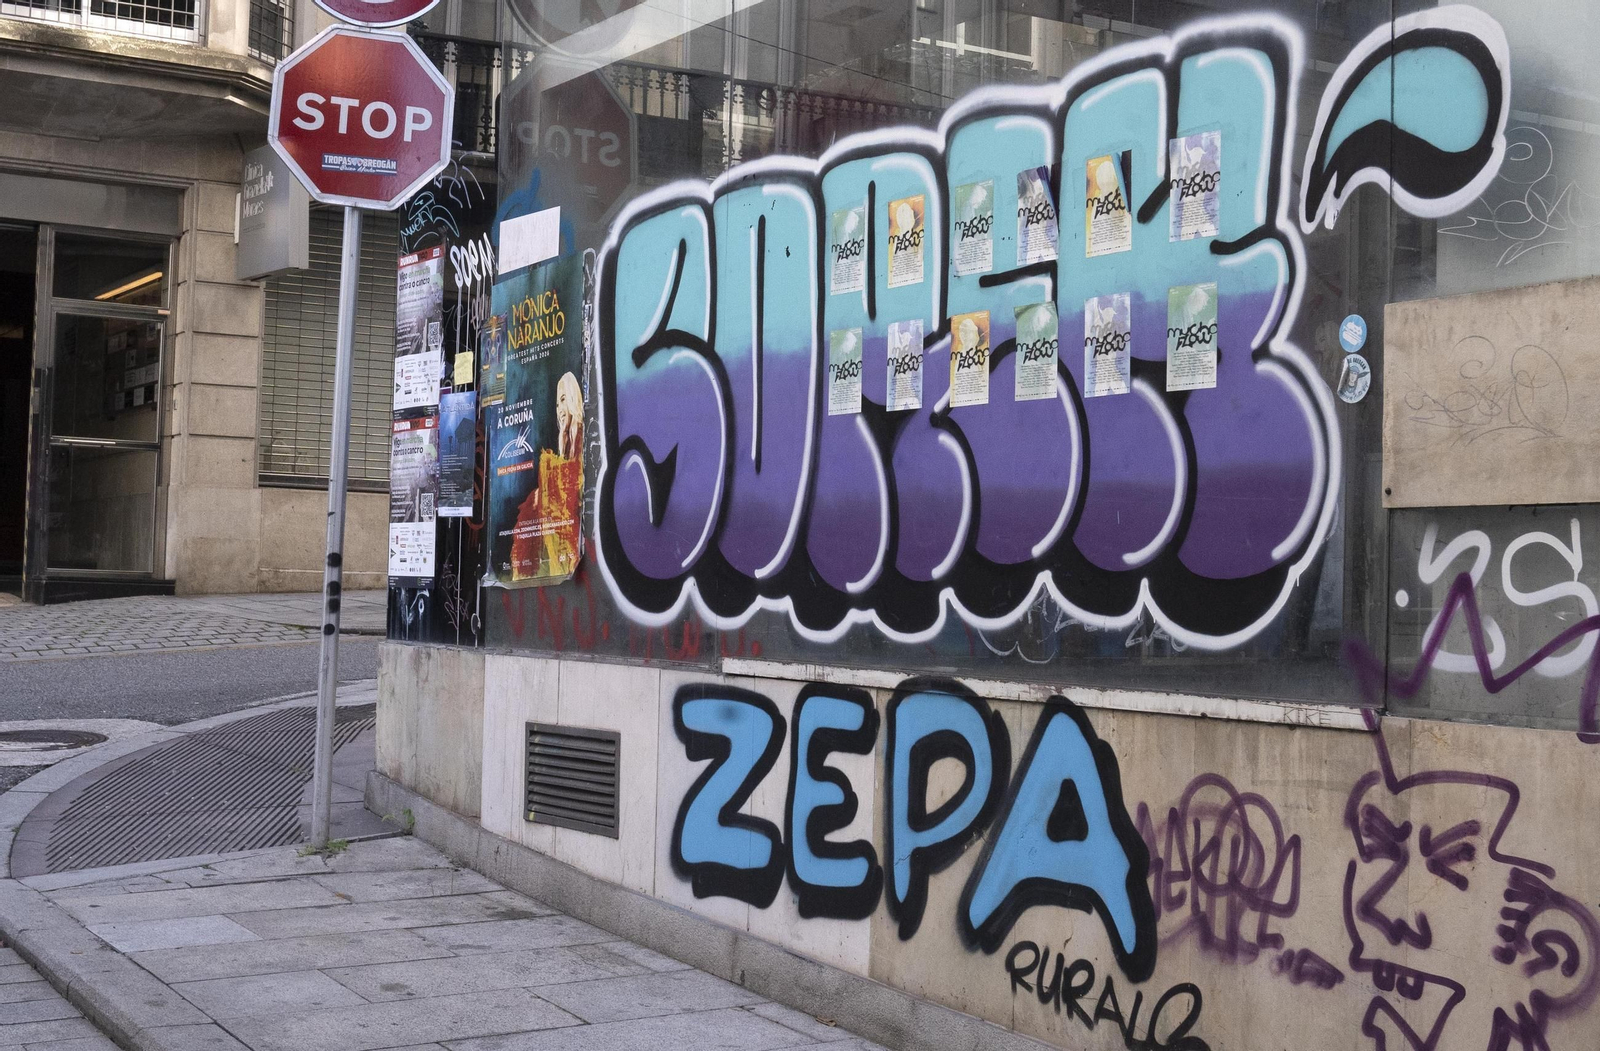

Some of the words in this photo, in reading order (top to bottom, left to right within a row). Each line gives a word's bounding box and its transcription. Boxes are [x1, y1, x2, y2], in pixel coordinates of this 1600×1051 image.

[292, 92, 433, 142] STOP
[323, 154, 352, 166] TROPAS
[512, 289, 559, 325] MÓNICA
[507, 311, 565, 351] NARANJO
[541, 337, 565, 350] CONCERTS
[505, 398, 533, 412] NOVIEMBRE
[497, 418, 503, 429] A
[504, 408, 534, 427] CORUÑA
[505, 447, 525, 459] COLISEUM
[673, 675, 1158, 985] ZEPA
